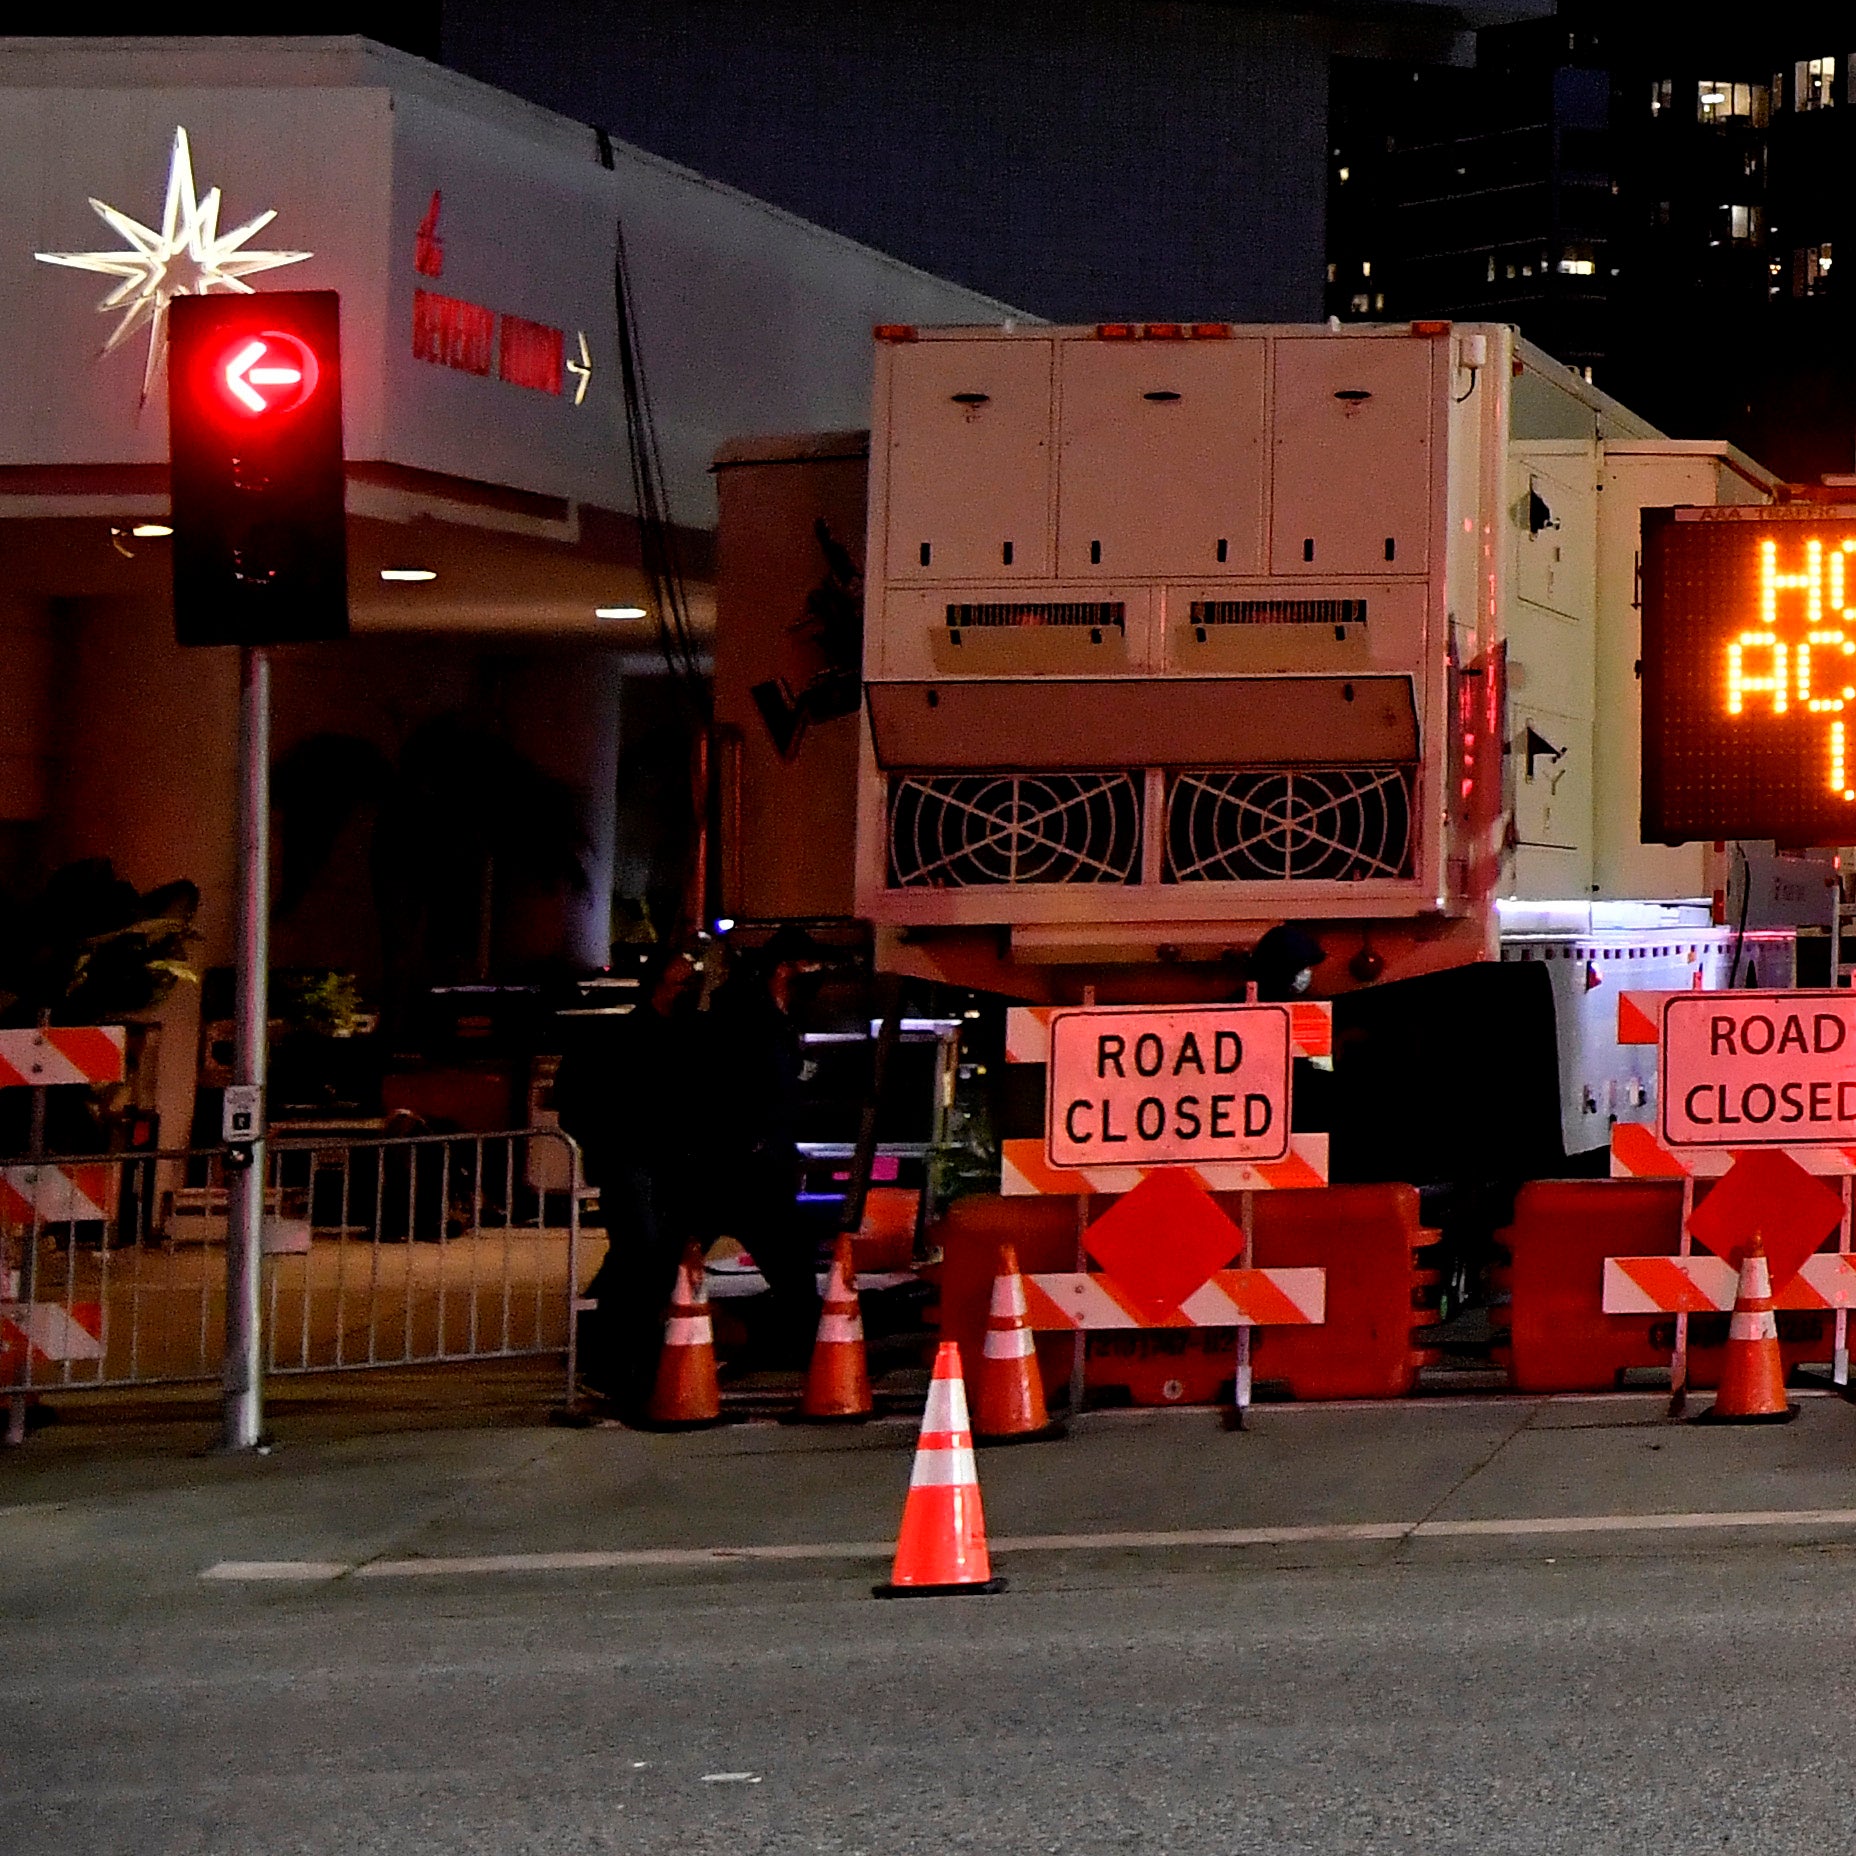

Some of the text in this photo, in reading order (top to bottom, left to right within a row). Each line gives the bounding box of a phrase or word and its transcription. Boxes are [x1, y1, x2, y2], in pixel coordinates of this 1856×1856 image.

[1097, 1030, 1245, 1079] ROAD
[1709, 1013, 1847, 1056] ROAD
[1065, 1092, 1273, 1144] CLOSED
